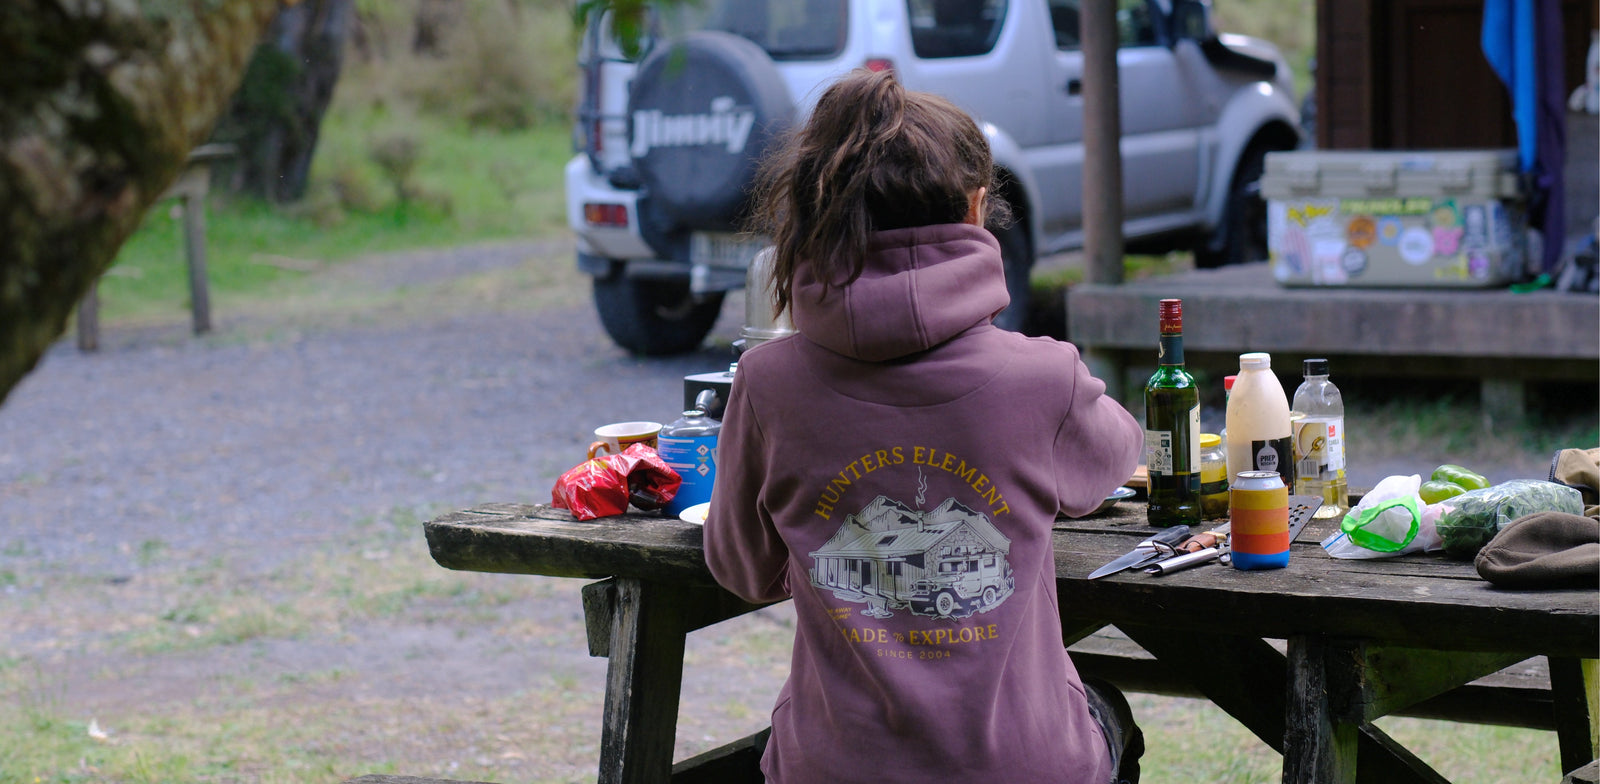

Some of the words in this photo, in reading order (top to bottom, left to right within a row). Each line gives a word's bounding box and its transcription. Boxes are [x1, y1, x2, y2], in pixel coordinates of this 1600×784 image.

[631, 96, 756, 158] Jimny
[1260, 454, 1276, 462] PREP
[814, 446, 905, 521] HUNTERS
[913, 446, 1010, 517] ELEMENT
[909, 624, 999, 646] EXPLORE
[877, 648, 913, 660] SINCE
[919, 649, 951, 659] 2004
